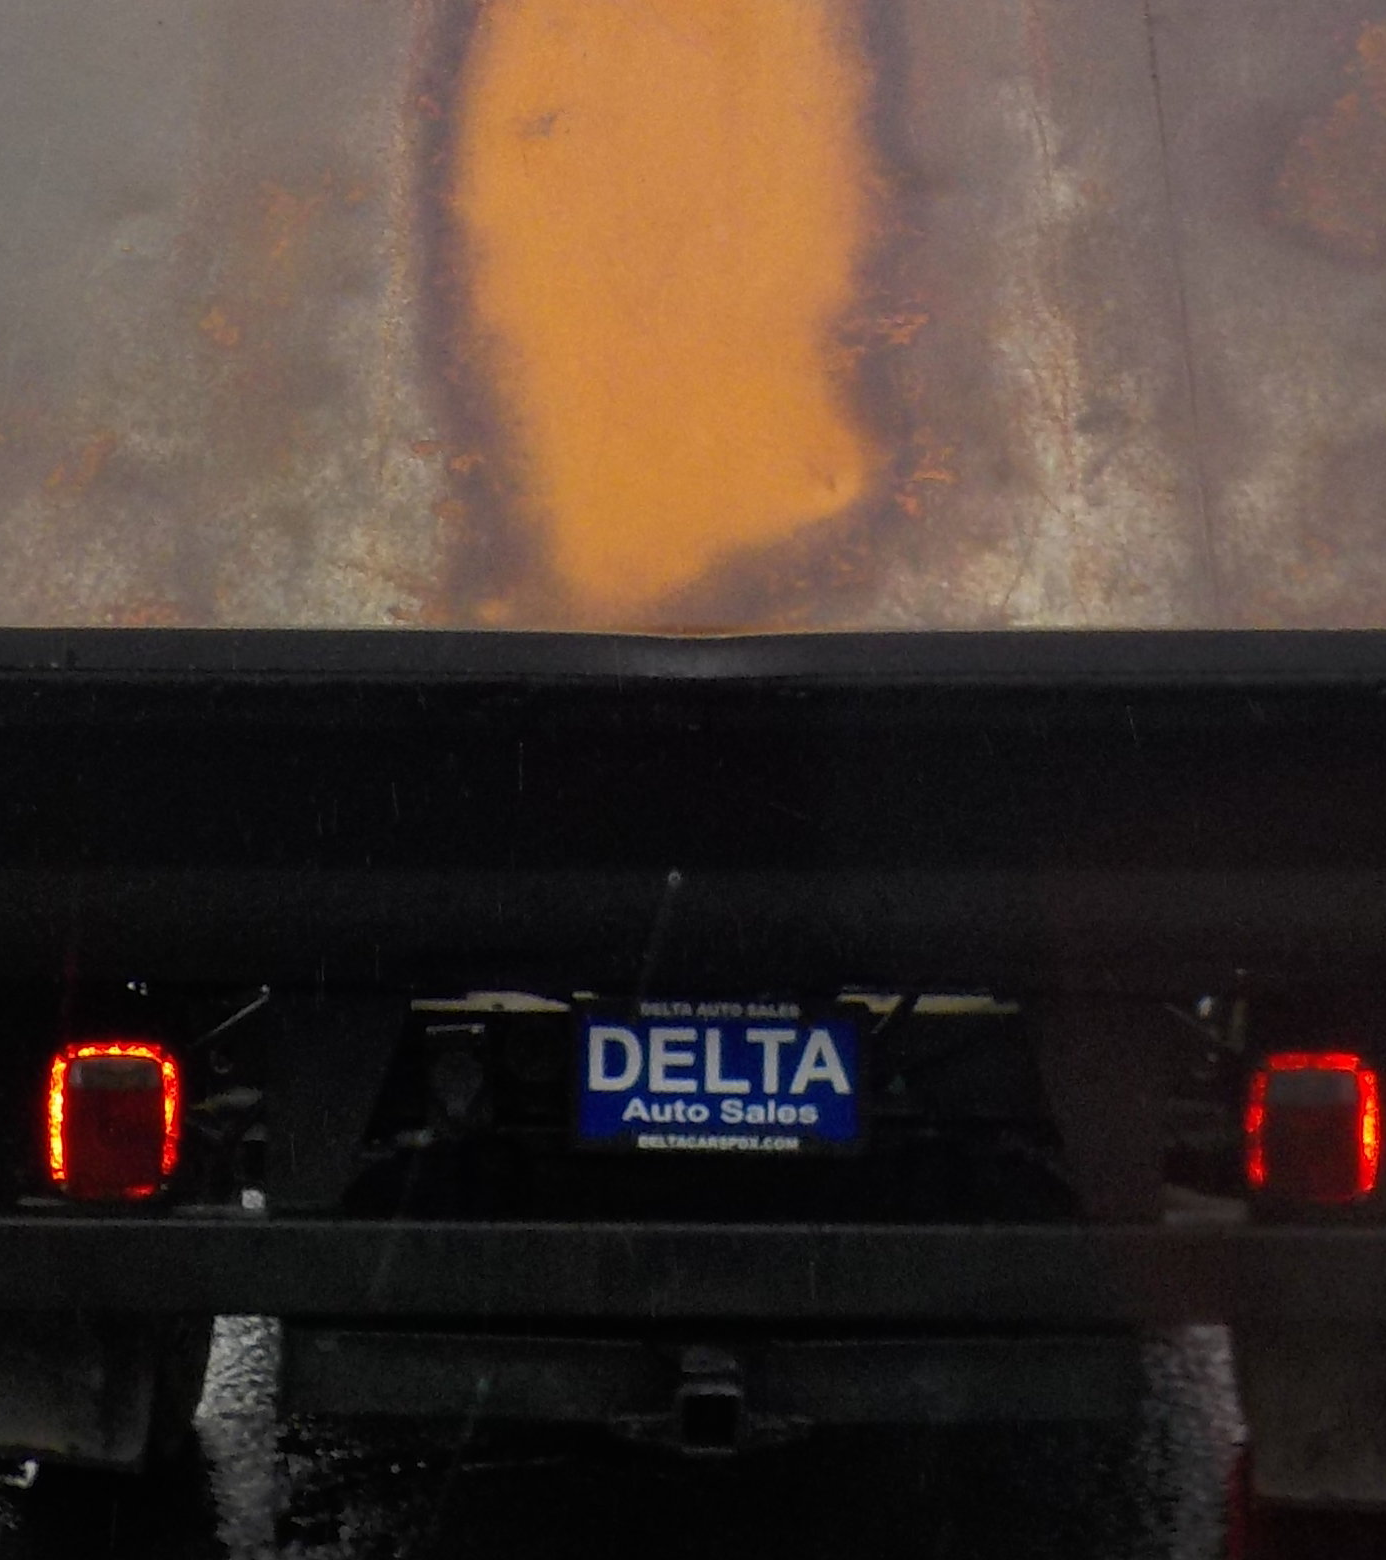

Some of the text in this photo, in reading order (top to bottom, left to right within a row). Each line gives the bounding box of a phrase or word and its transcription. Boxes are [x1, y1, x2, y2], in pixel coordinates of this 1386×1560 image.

[640, 1002, 800, 1019] DELTA AUTO SALES
[588, 1026, 852, 1095] DELTA
[622, 1097, 819, 1125] Auto Sales
